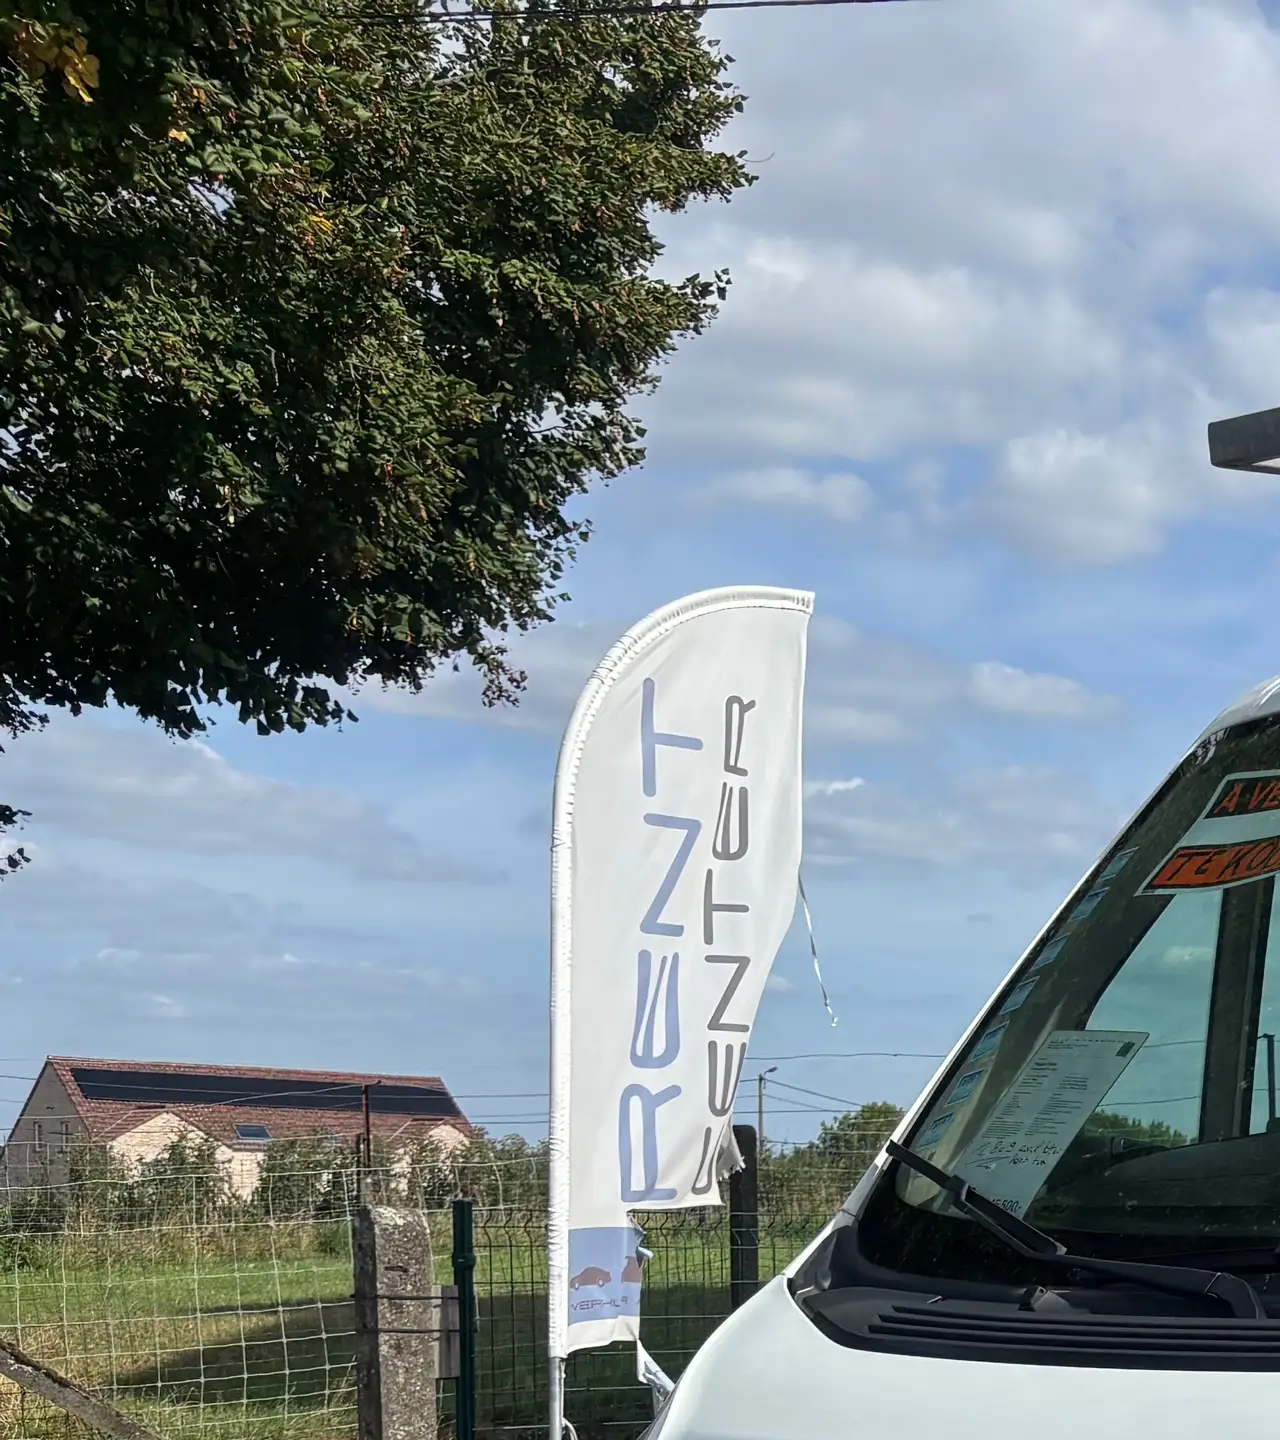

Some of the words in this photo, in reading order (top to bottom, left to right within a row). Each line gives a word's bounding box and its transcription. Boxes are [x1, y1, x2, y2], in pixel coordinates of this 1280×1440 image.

[1213, 782, 1243, 815] A
[1166, 849, 1227, 882] TE
[618, 677, 703, 1204] RENT
